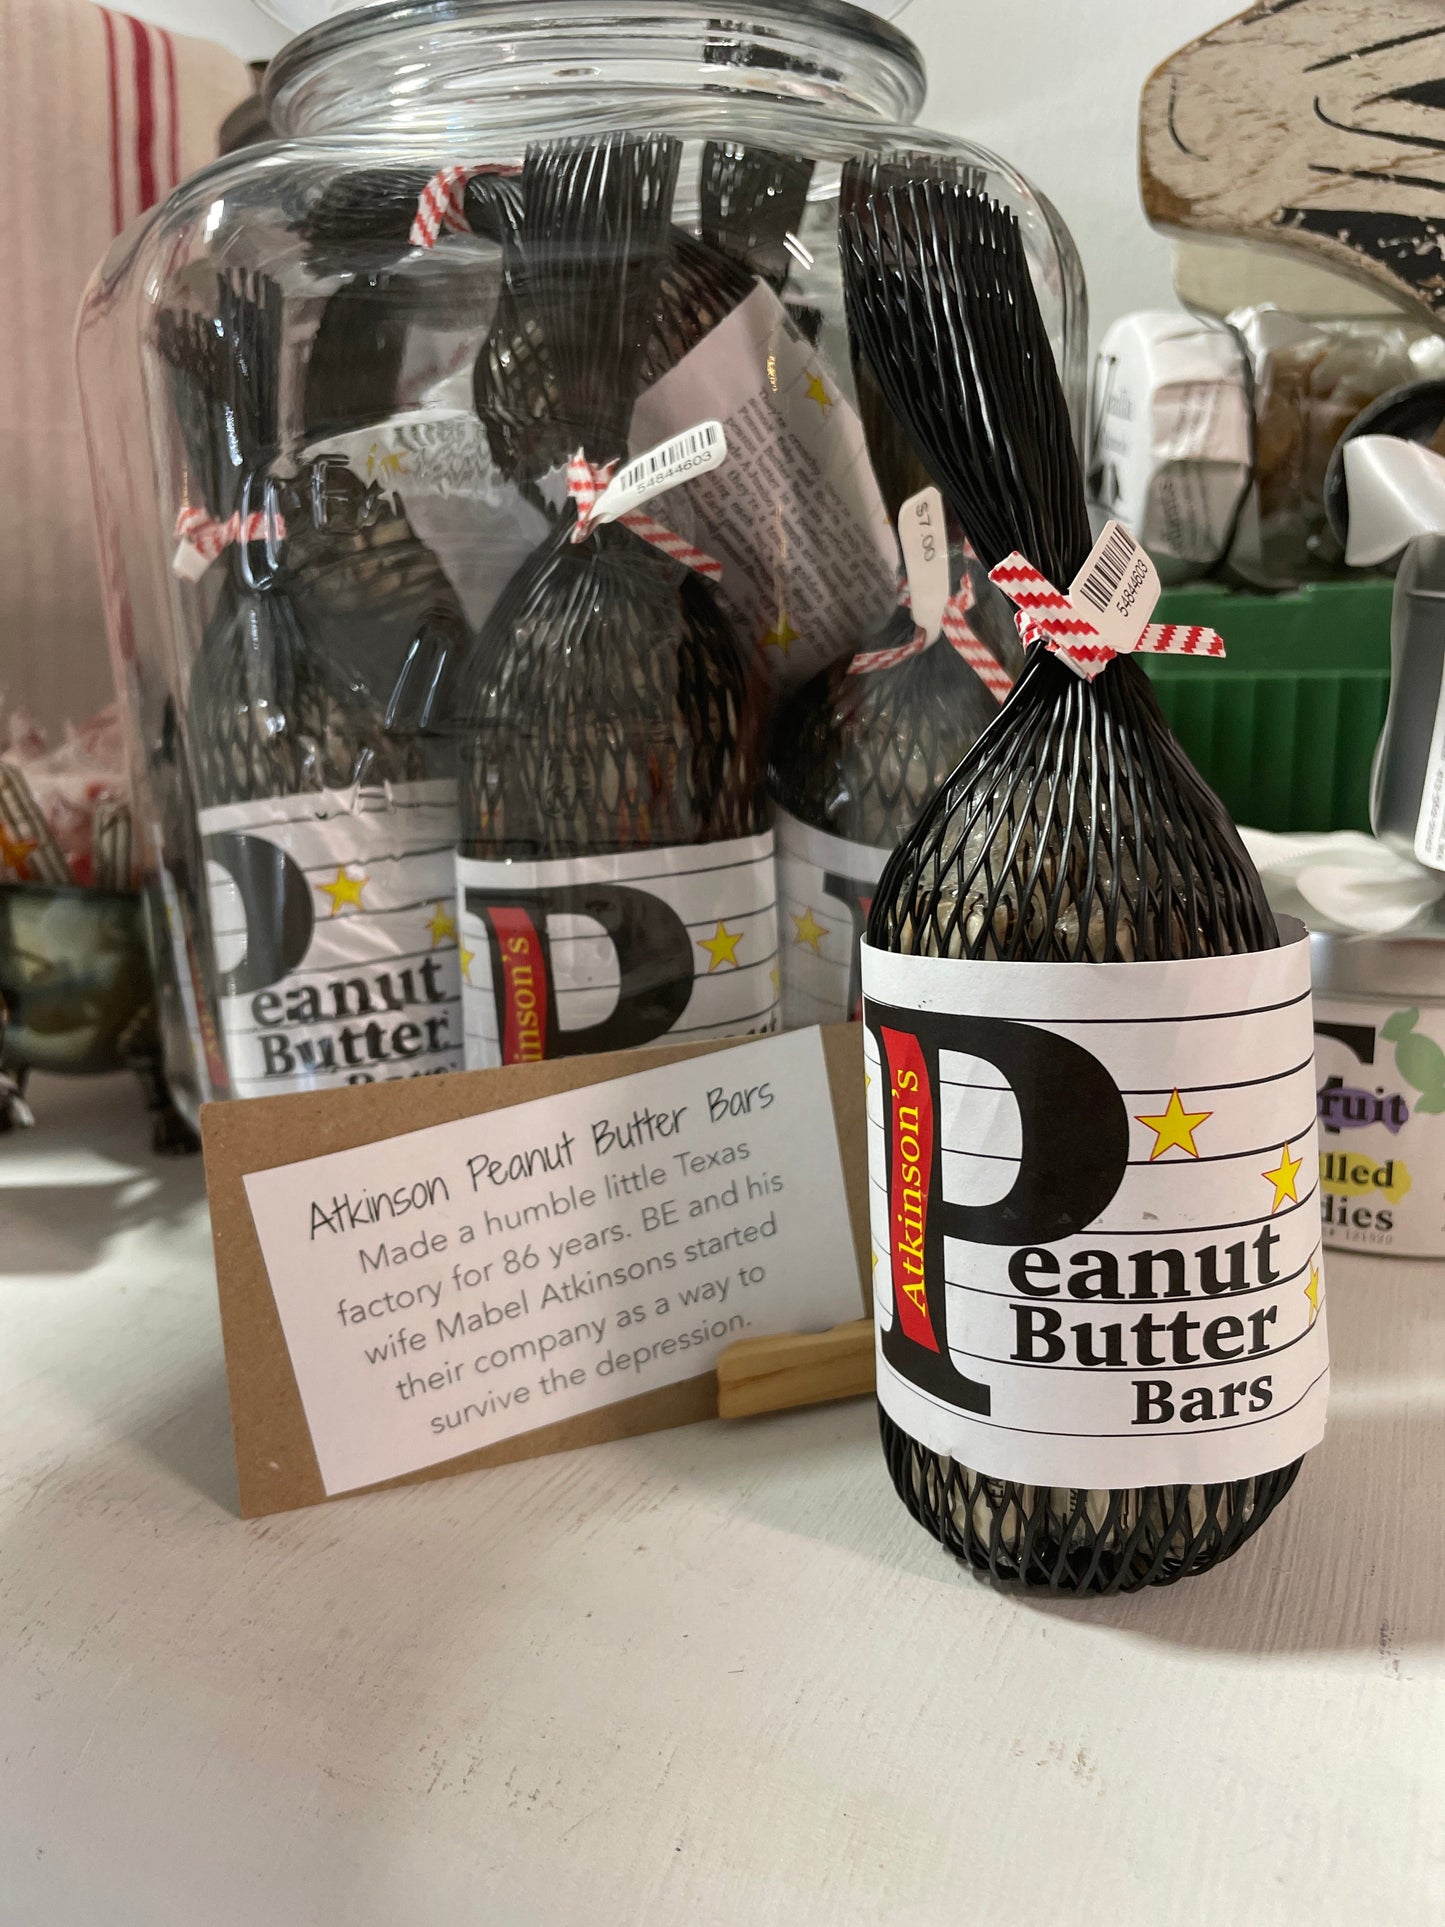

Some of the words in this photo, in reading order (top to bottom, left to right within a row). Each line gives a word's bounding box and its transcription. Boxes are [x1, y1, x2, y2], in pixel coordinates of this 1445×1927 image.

[637, 451, 712, 494] 54844603
[916, 502, 935, 562] $7.00
[1116, 559, 1148, 617] 54844603
[502, 937, 543, 1062] inson's
[258, 1015, 450, 1077] Butter
[310, 1176, 450, 1241] Atkinson
[466, 1131, 575, 1192] Peanut
[591, 1107, 688, 1156] Butter
[706, 1082, 775, 1123] Bars
[359, 1230, 448, 1273] Made
[459, 1225, 475, 1244] a
[484, 1185, 596, 1236] humble
[604, 1163, 667, 1199] little
[673, 1141, 750, 1177] Texas
[891, 1069, 927, 1316] Atkinson's
[1323, 1151, 1395, 1189] lled
[337, 1280, 442, 1326] factory
[452, 1263, 493, 1291] for
[503, 1244, 540, 1274] 86
[548, 1223, 632, 1269] years.
[641, 1199, 680, 1233] BE
[688, 1180, 738, 1218] and
[746, 1172, 784, 1200] his
[1321, 1193, 1395, 1232] dies
[364, 1328, 427, 1365] wife
[436, 1289, 529, 1343] Mabel
[541, 1251, 677, 1309] Atkinsons
[684, 1210, 778, 1263] started
[395, 1361, 464, 1401] their
[474, 1317, 607, 1374] company
[616, 1304, 646, 1328] as
[655, 1297, 670, 1316] a
[678, 1276, 730, 1306] way
[738, 1265, 766, 1287] to
[430, 1386, 530, 1434] survive
[539, 1367, 587, 1395] the
[596, 1314, 752, 1377] depression.
[1008, 1304, 1277, 1368] Butter
[1130, 1374, 1274, 1426] Bars
